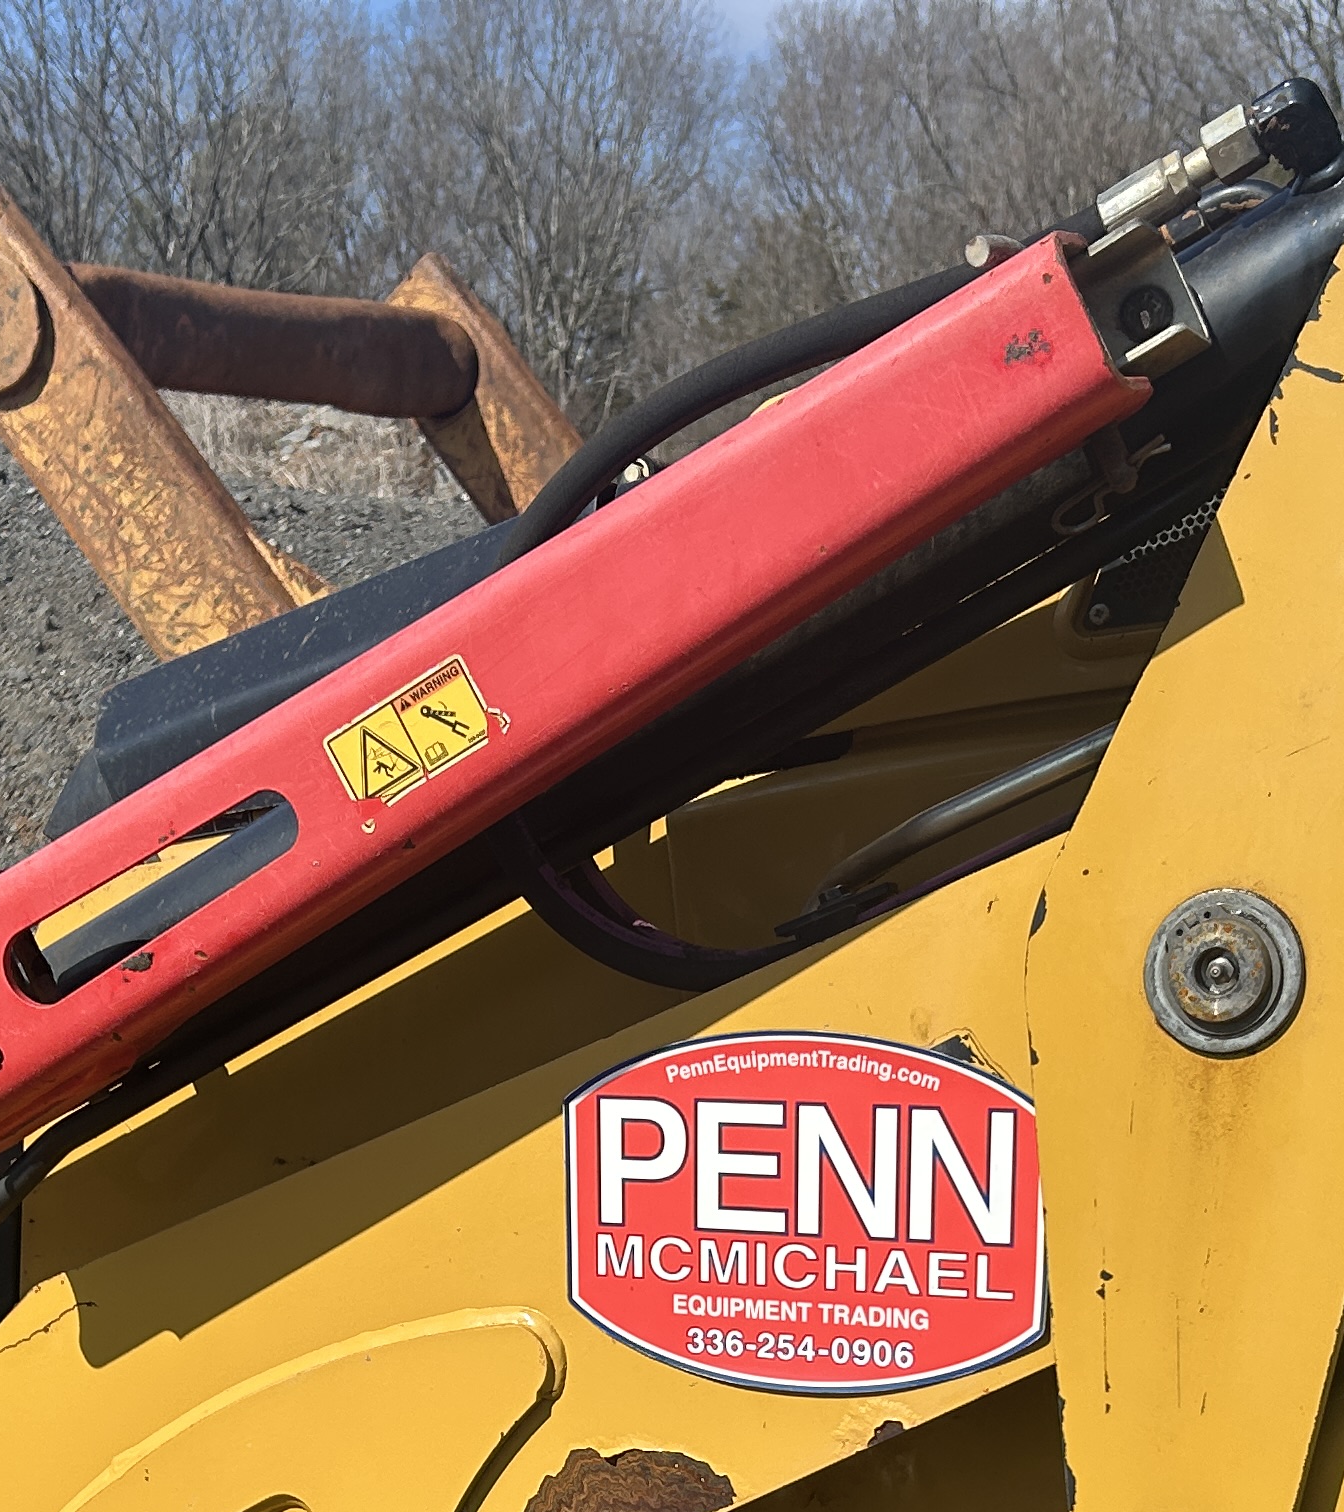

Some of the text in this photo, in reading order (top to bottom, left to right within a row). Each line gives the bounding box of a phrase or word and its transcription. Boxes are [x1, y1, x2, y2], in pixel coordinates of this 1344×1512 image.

[409, 666, 459, 703] WARNING
[665, 1049, 941, 1091] PennEquipmentTrading.com
[596, 1095, 1018, 1247] PENN
[595, 1231, 1016, 1301] MCMICHAEL
[672, 1293, 929, 1331] EQUIPMENT TRADING
[686, 1327, 915, 1371] 336-254-0906
